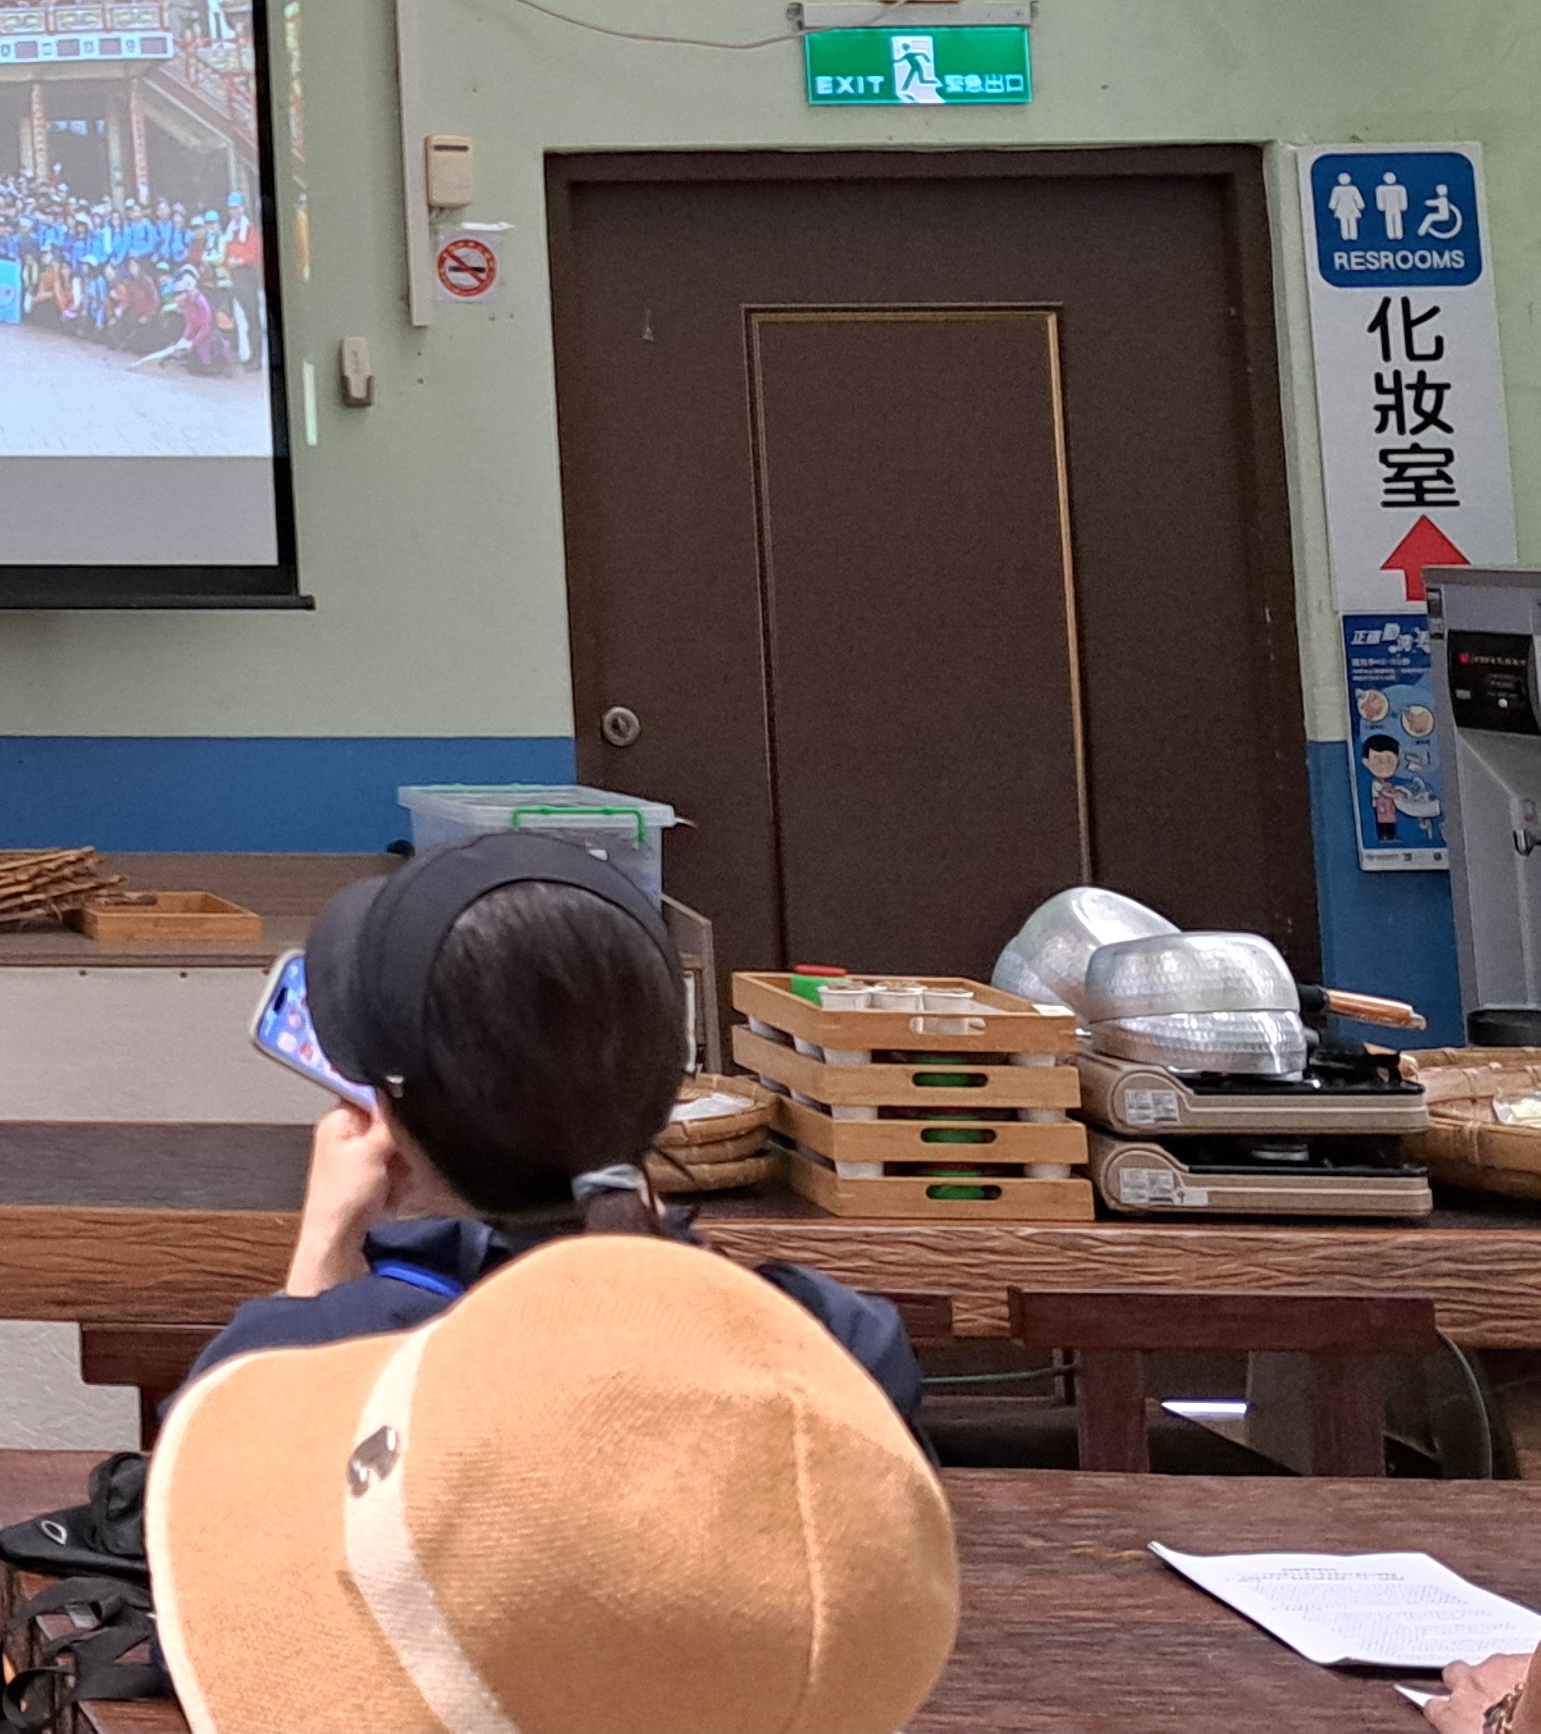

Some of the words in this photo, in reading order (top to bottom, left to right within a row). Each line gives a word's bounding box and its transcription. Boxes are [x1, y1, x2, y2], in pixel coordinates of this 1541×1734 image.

[816, 75, 885, 95] EXIT
[1333, 249, 1466, 271] RESROOMS
[1366, 296, 1461, 508] 化妝室
